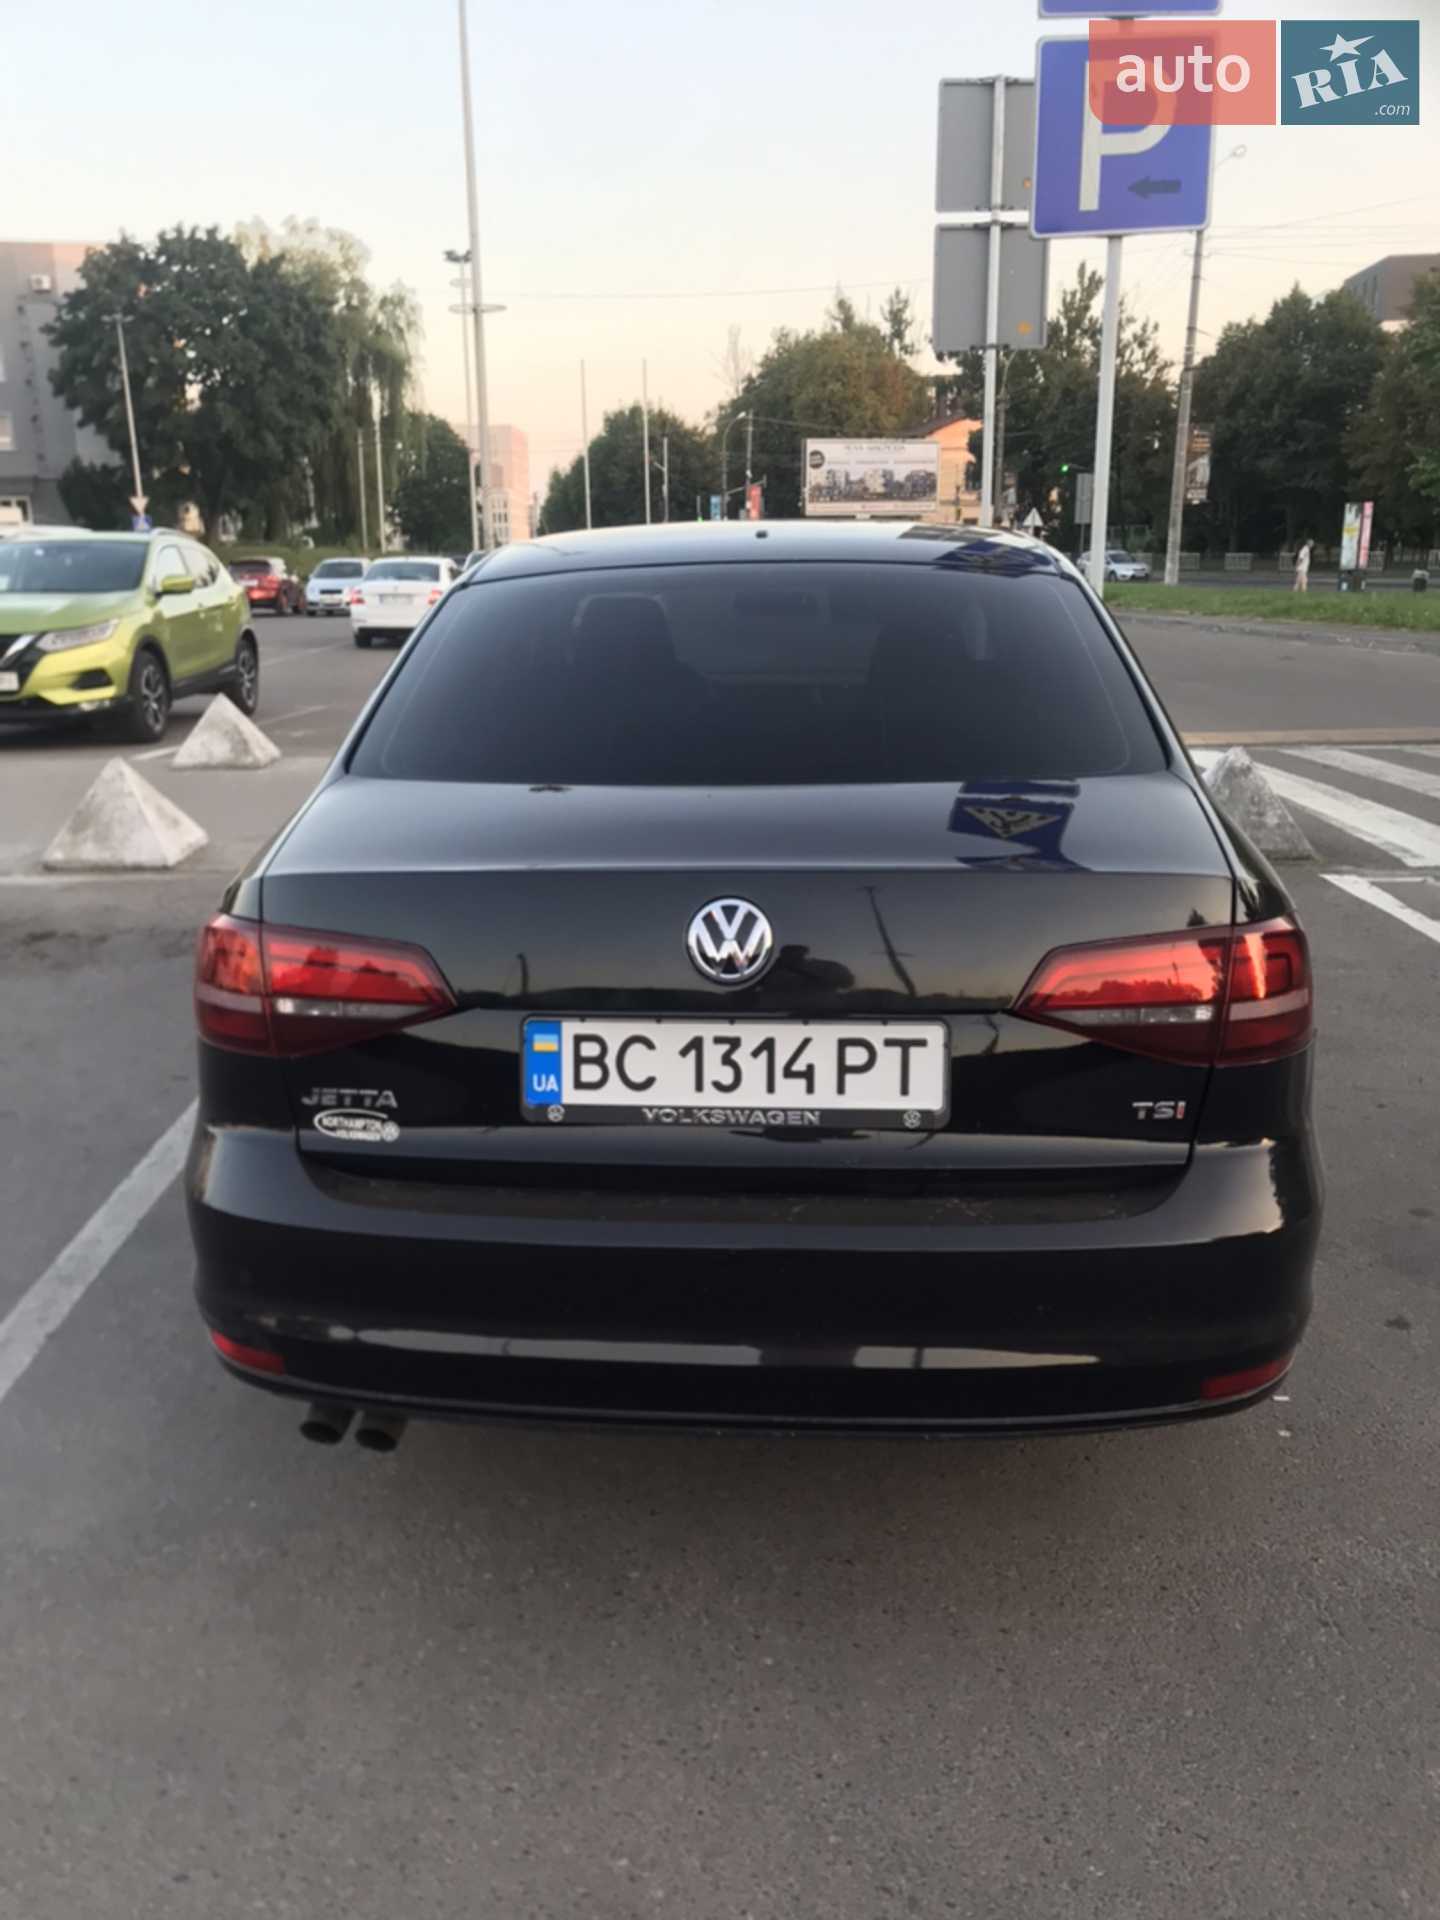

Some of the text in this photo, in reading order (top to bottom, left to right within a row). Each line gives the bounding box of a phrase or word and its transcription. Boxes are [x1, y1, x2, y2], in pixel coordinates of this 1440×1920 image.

[1079, 60, 1178, 212] P
[572, 1034, 928, 1097] BC 1314 PT
[533, 1075, 559, 1092] UA
[301, 1087, 398, 1108] JETTA
[642, 1107, 821, 1126] VOLKSWAGEN
[1132, 1101, 1186, 1119] TSI
